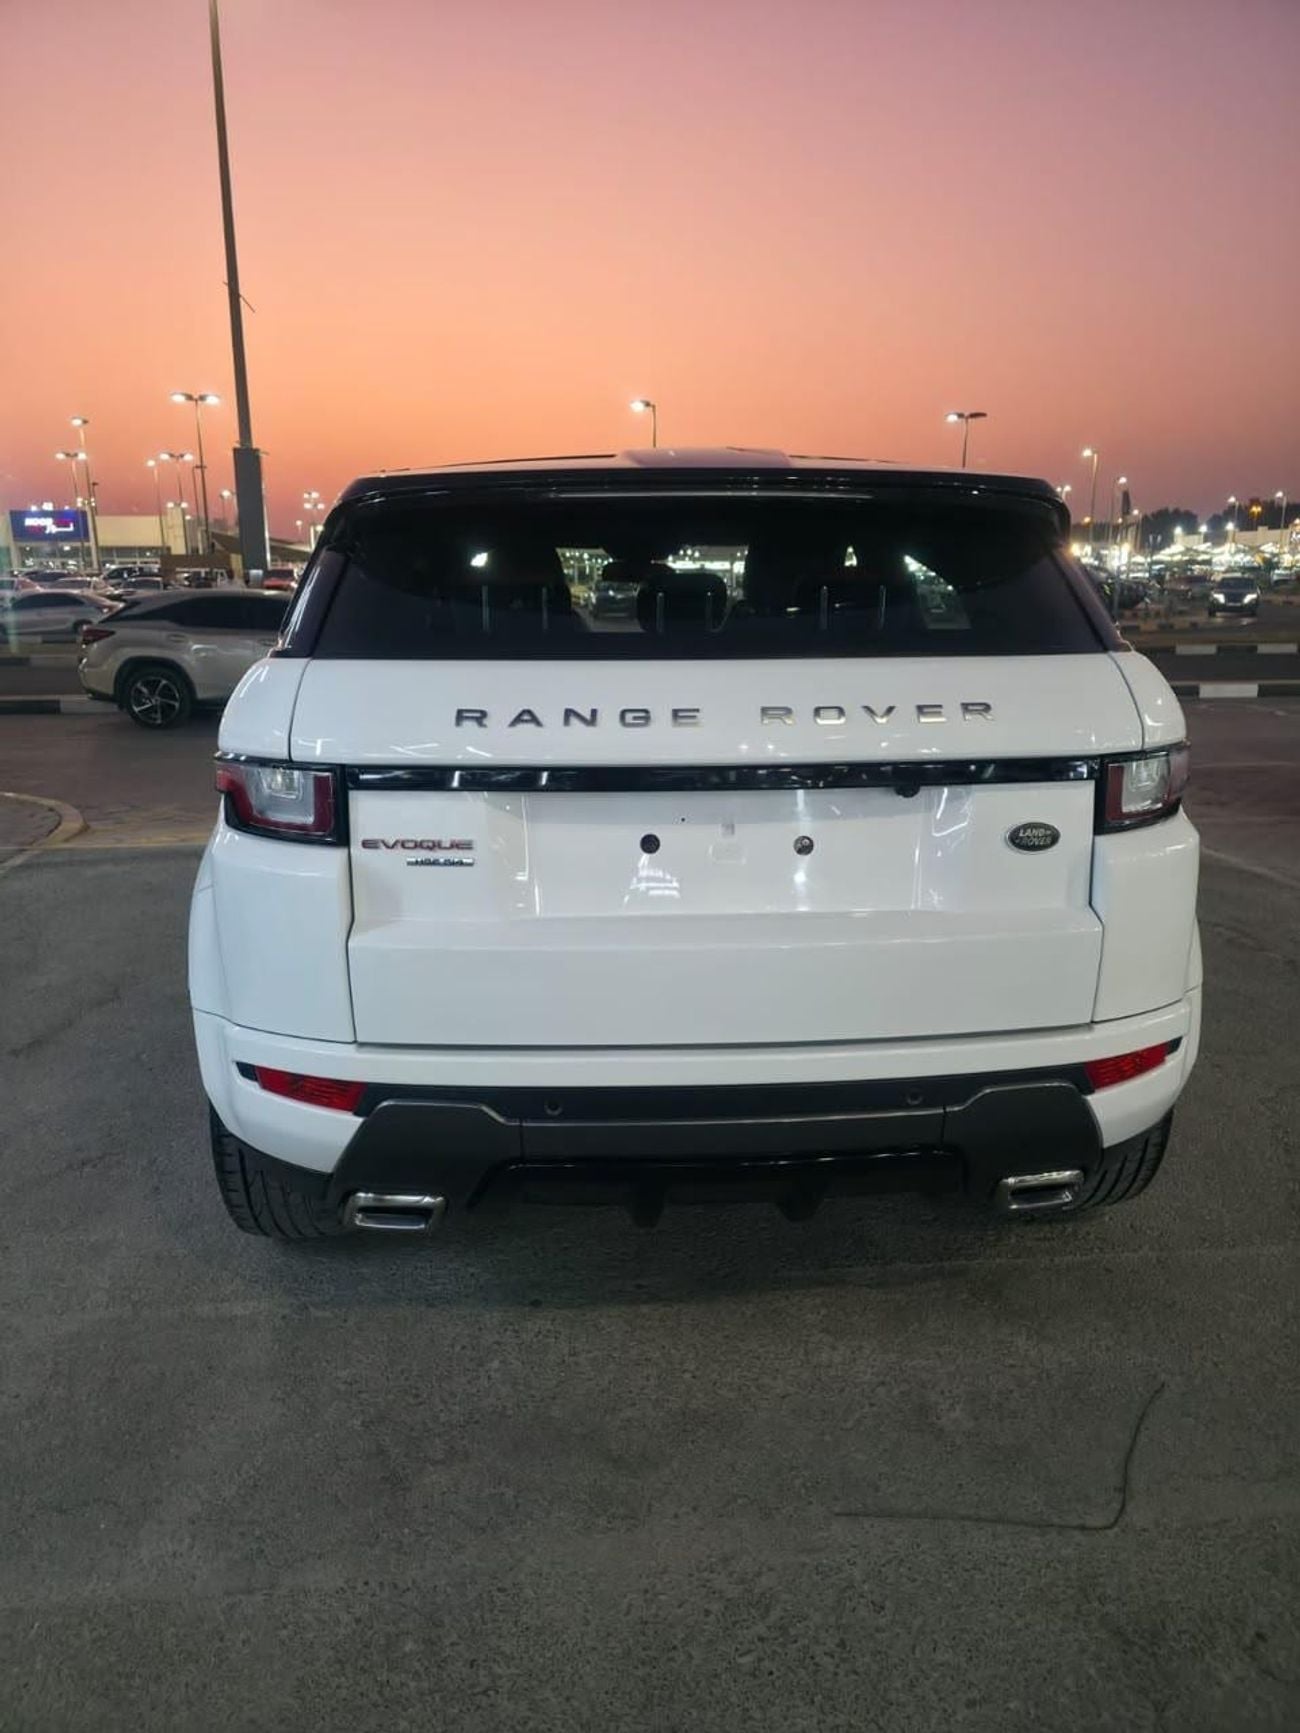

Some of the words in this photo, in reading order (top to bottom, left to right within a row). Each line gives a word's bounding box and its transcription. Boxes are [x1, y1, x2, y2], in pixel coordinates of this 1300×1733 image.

[455, 708, 701, 727] RANGE
[760, 702, 994, 725] ROVER
[361, 839, 473, 851] EVOQUE
